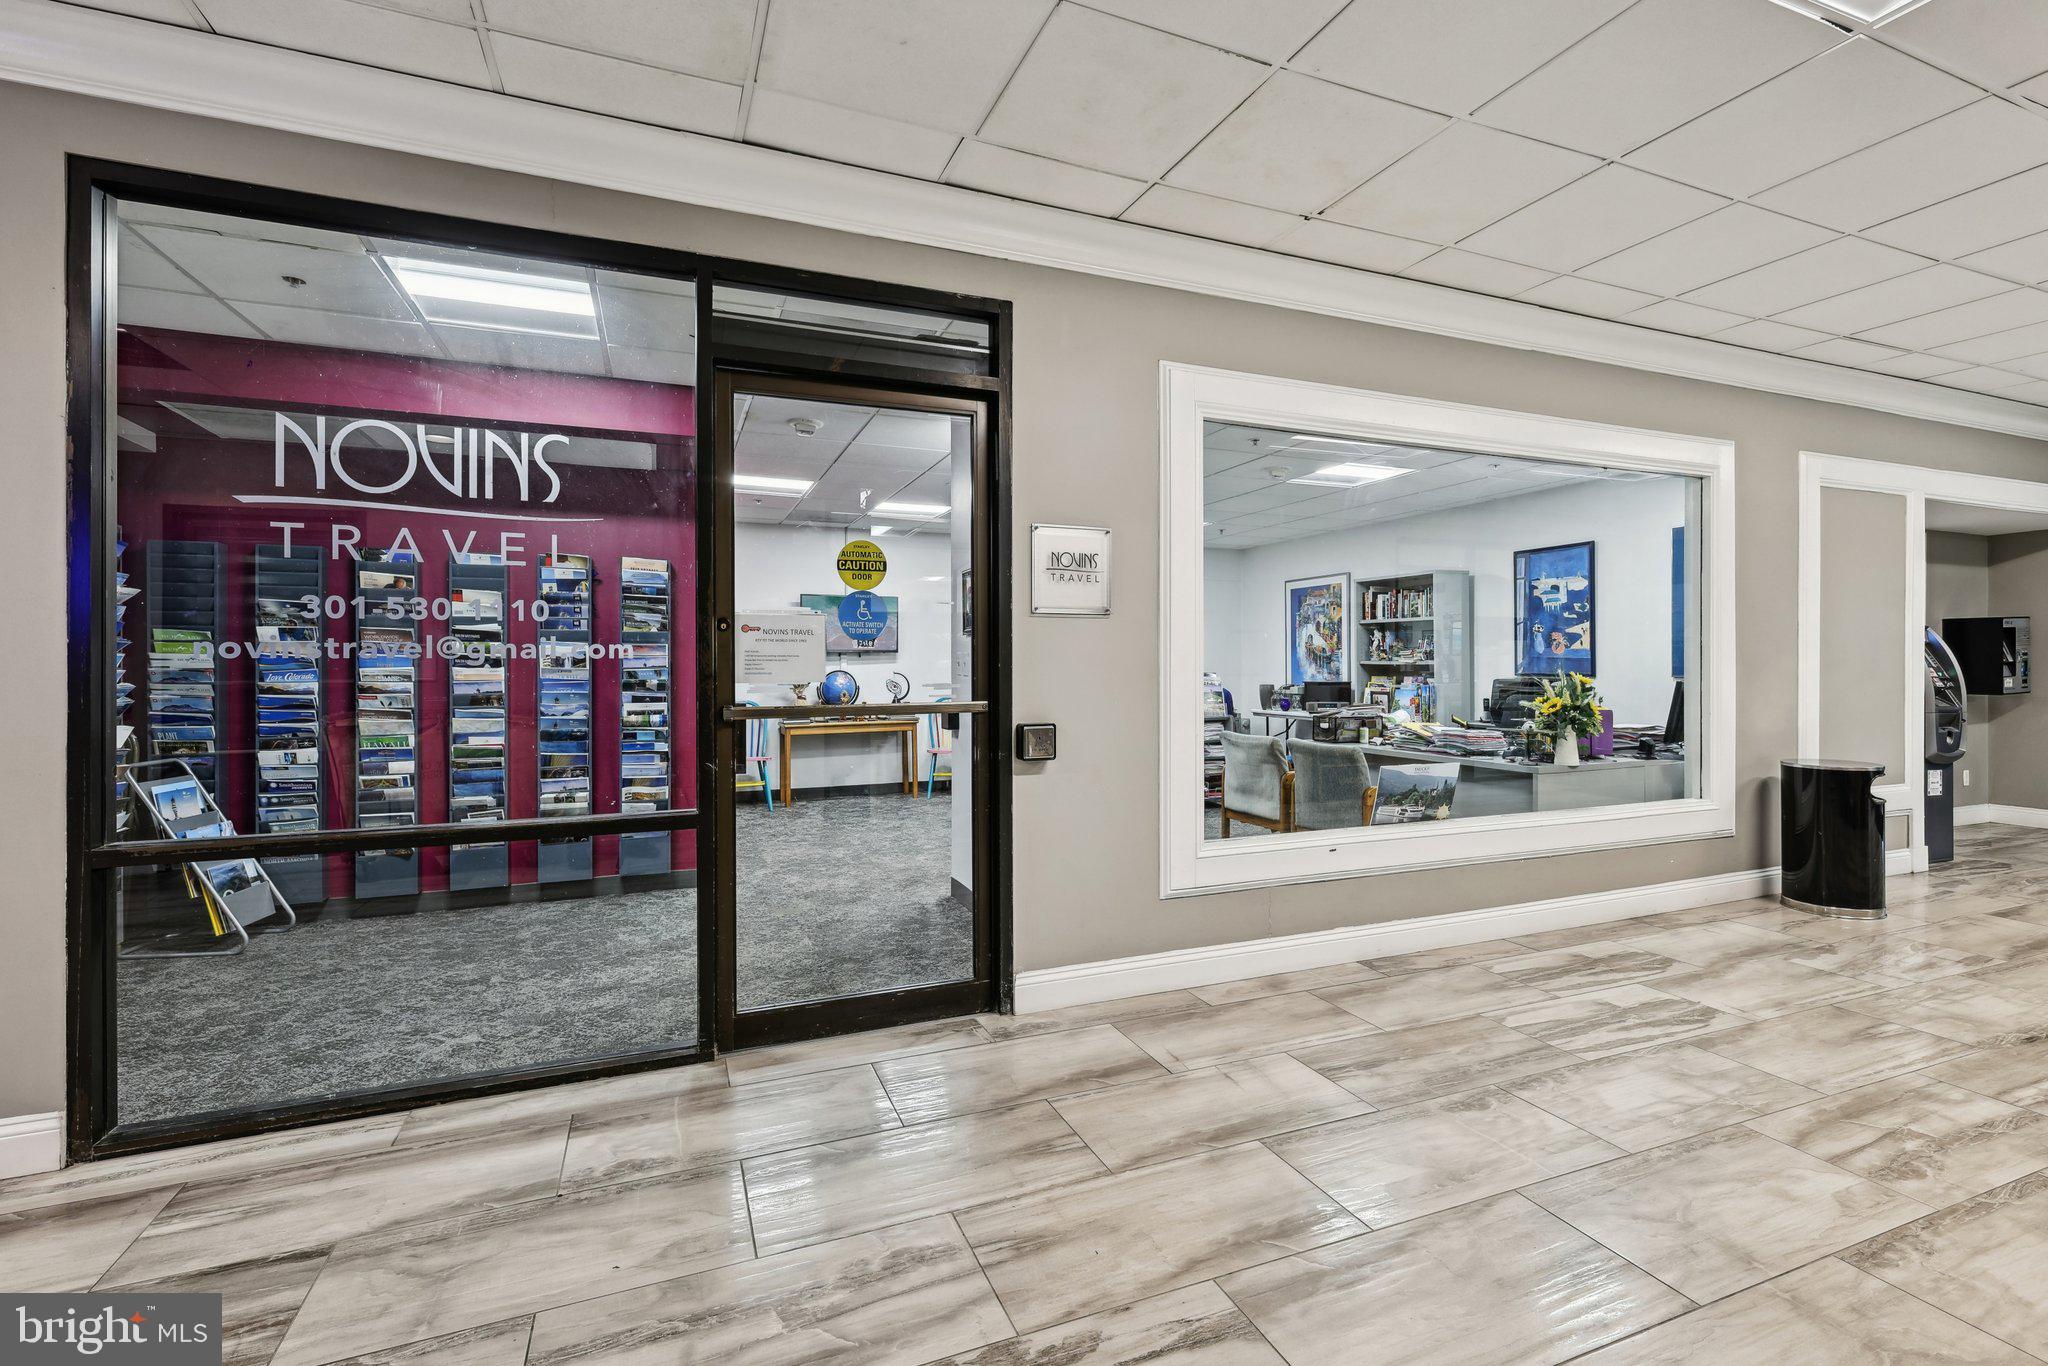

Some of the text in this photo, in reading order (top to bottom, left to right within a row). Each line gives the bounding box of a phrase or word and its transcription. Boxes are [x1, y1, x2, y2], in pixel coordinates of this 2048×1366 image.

[275, 411, 570, 503] NOVINS
[269, 521, 563, 567] TRAVEL
[841, 550, 883, 559] AUTOMATIC
[1051, 551, 1099, 569] NOVINS
[838, 560, 885, 571] CAUTION
[1050, 573, 1100, 583] TRAVEL
[300, 594, 550, 622] 301-530-1110
[790, 628, 815, 636] TRAVEL
[193, 634, 634, 667] novinstravel@gmail.com
[266, 672, 315, 682] Love Colorado
[157, 732, 179, 740] PLANT
